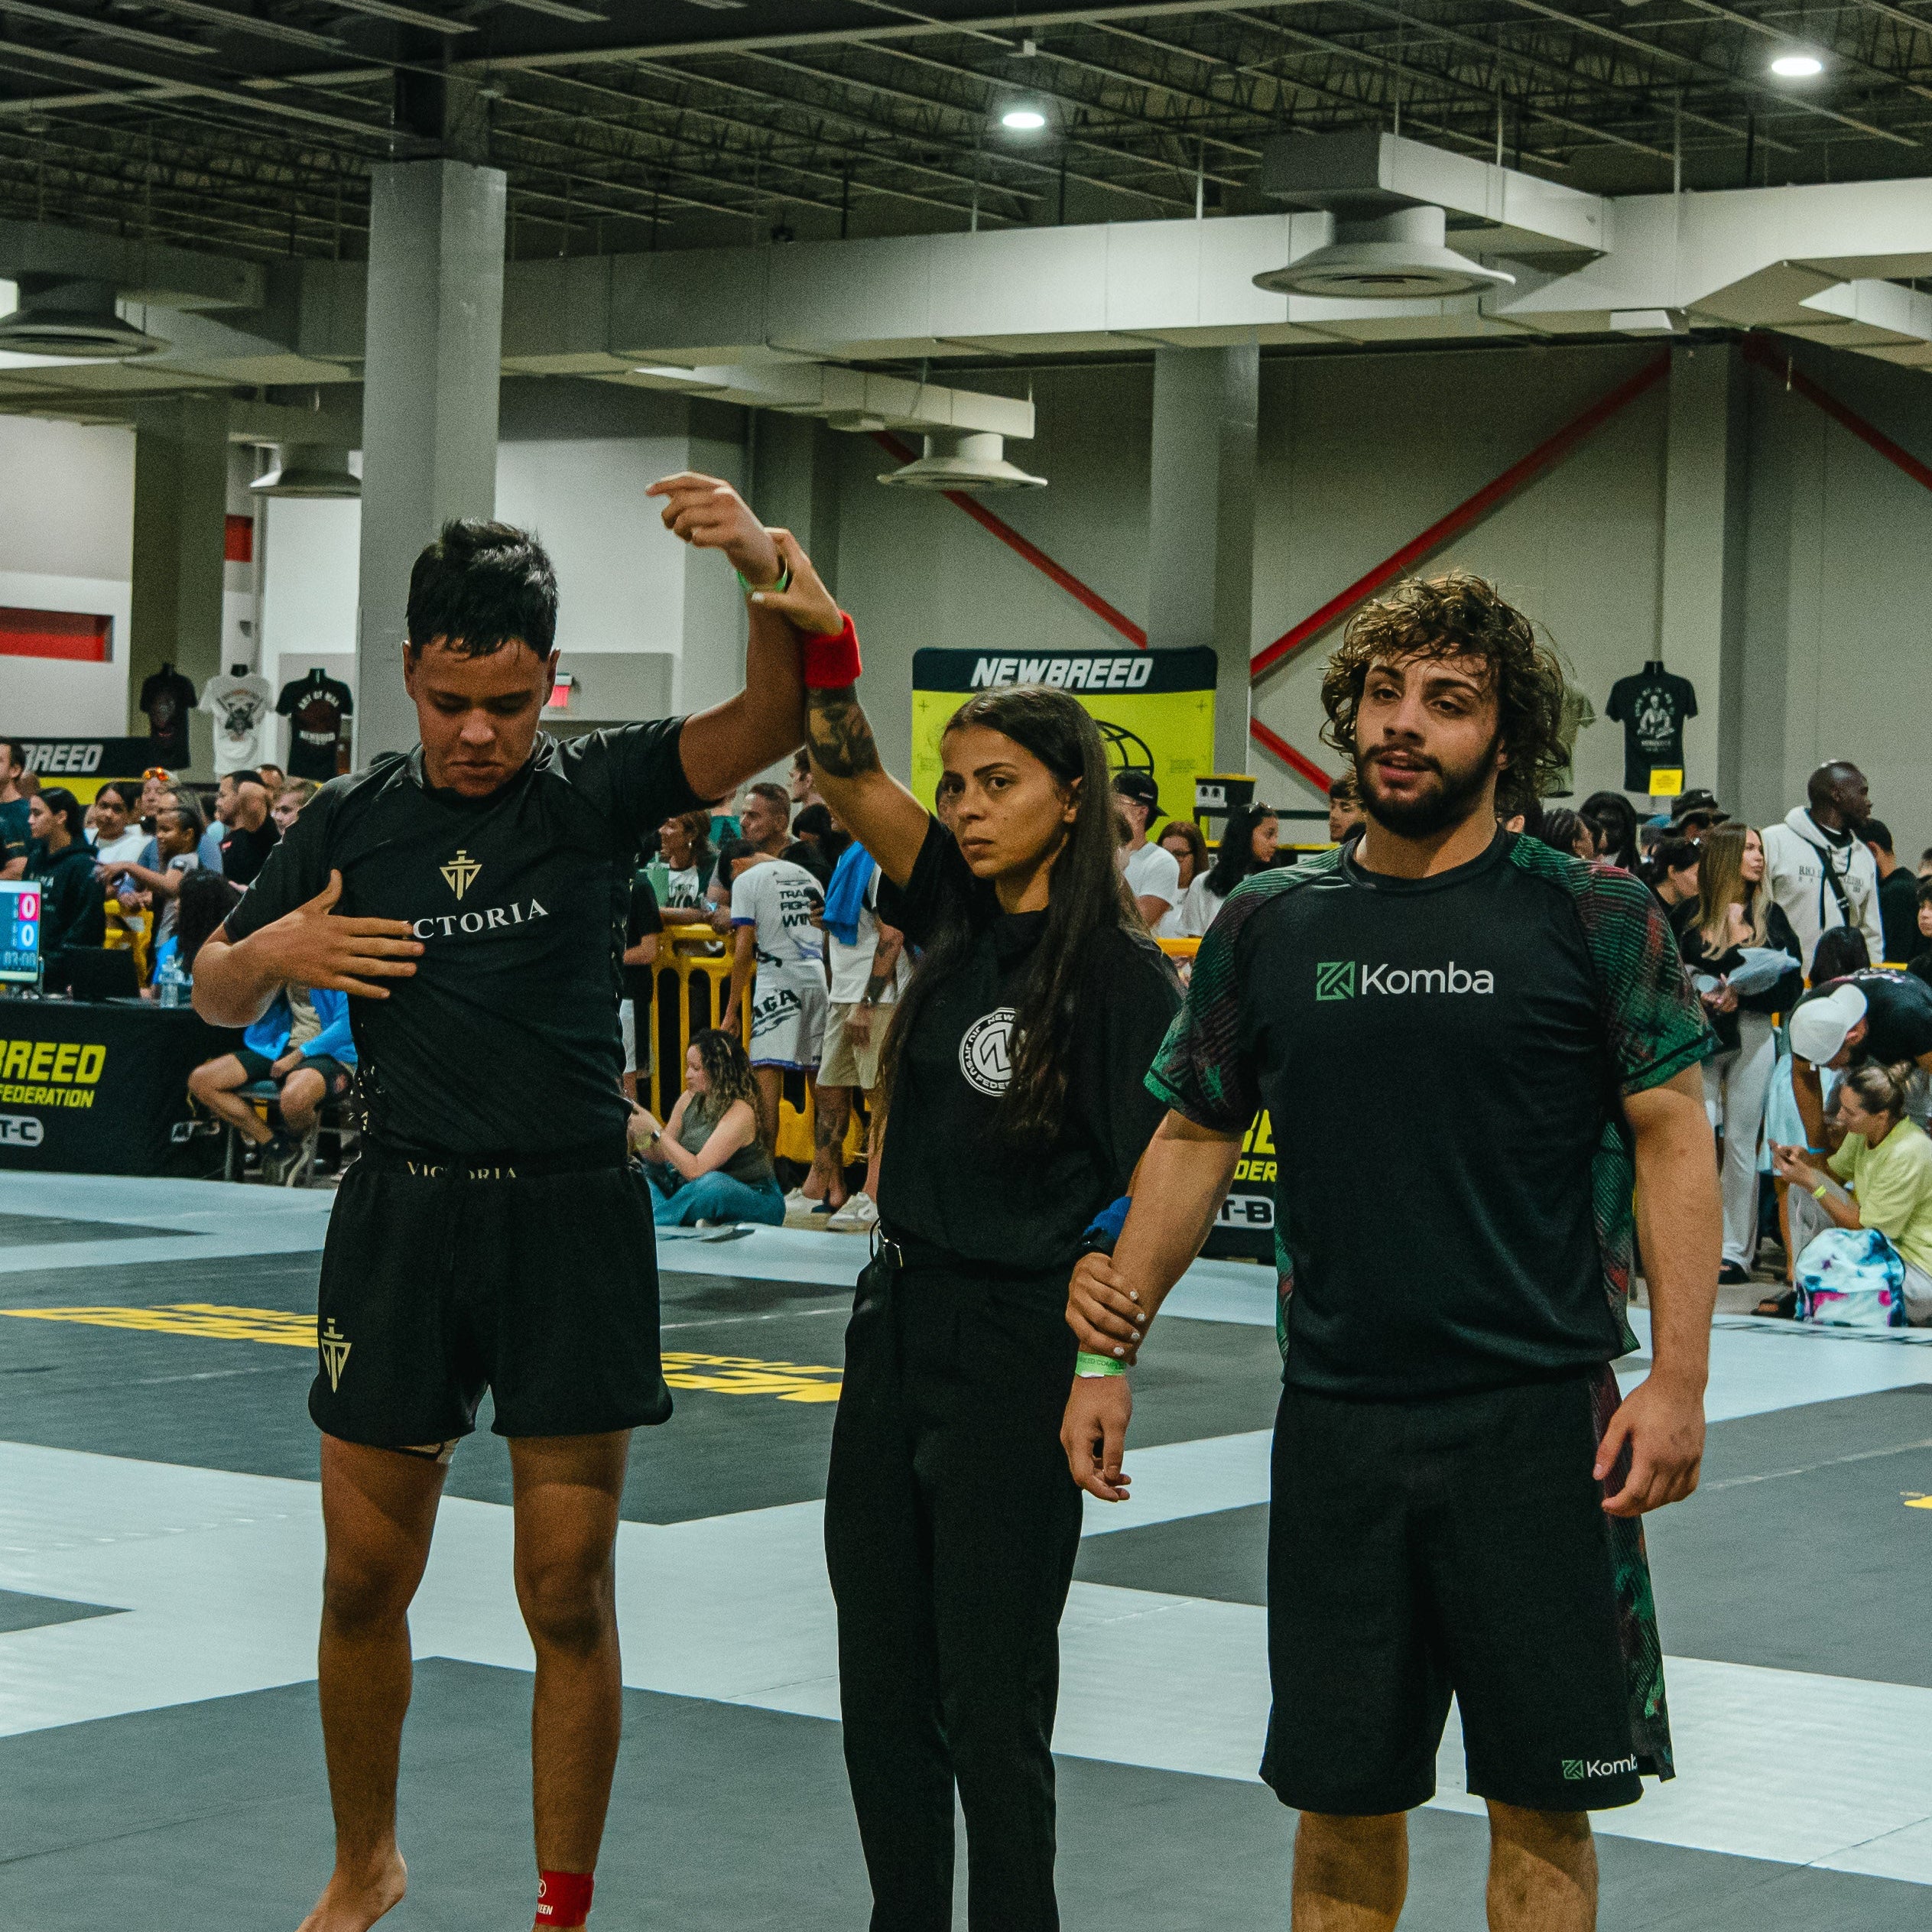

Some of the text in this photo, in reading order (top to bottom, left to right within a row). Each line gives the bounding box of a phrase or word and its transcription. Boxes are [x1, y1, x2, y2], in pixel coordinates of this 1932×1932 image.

[970, 658, 1154, 688] NEWBREED
[22, 895, 36, 919] 0
[411, 898, 549, 939] CTORIA
[21, 924, 34, 947] 0
[1362, 961, 1494, 995] Komba
[988, 1014, 1015, 1025] NEW
[975, 1073, 1010, 1089] FEDE
[408, 1161, 517, 1180] VICRIA
